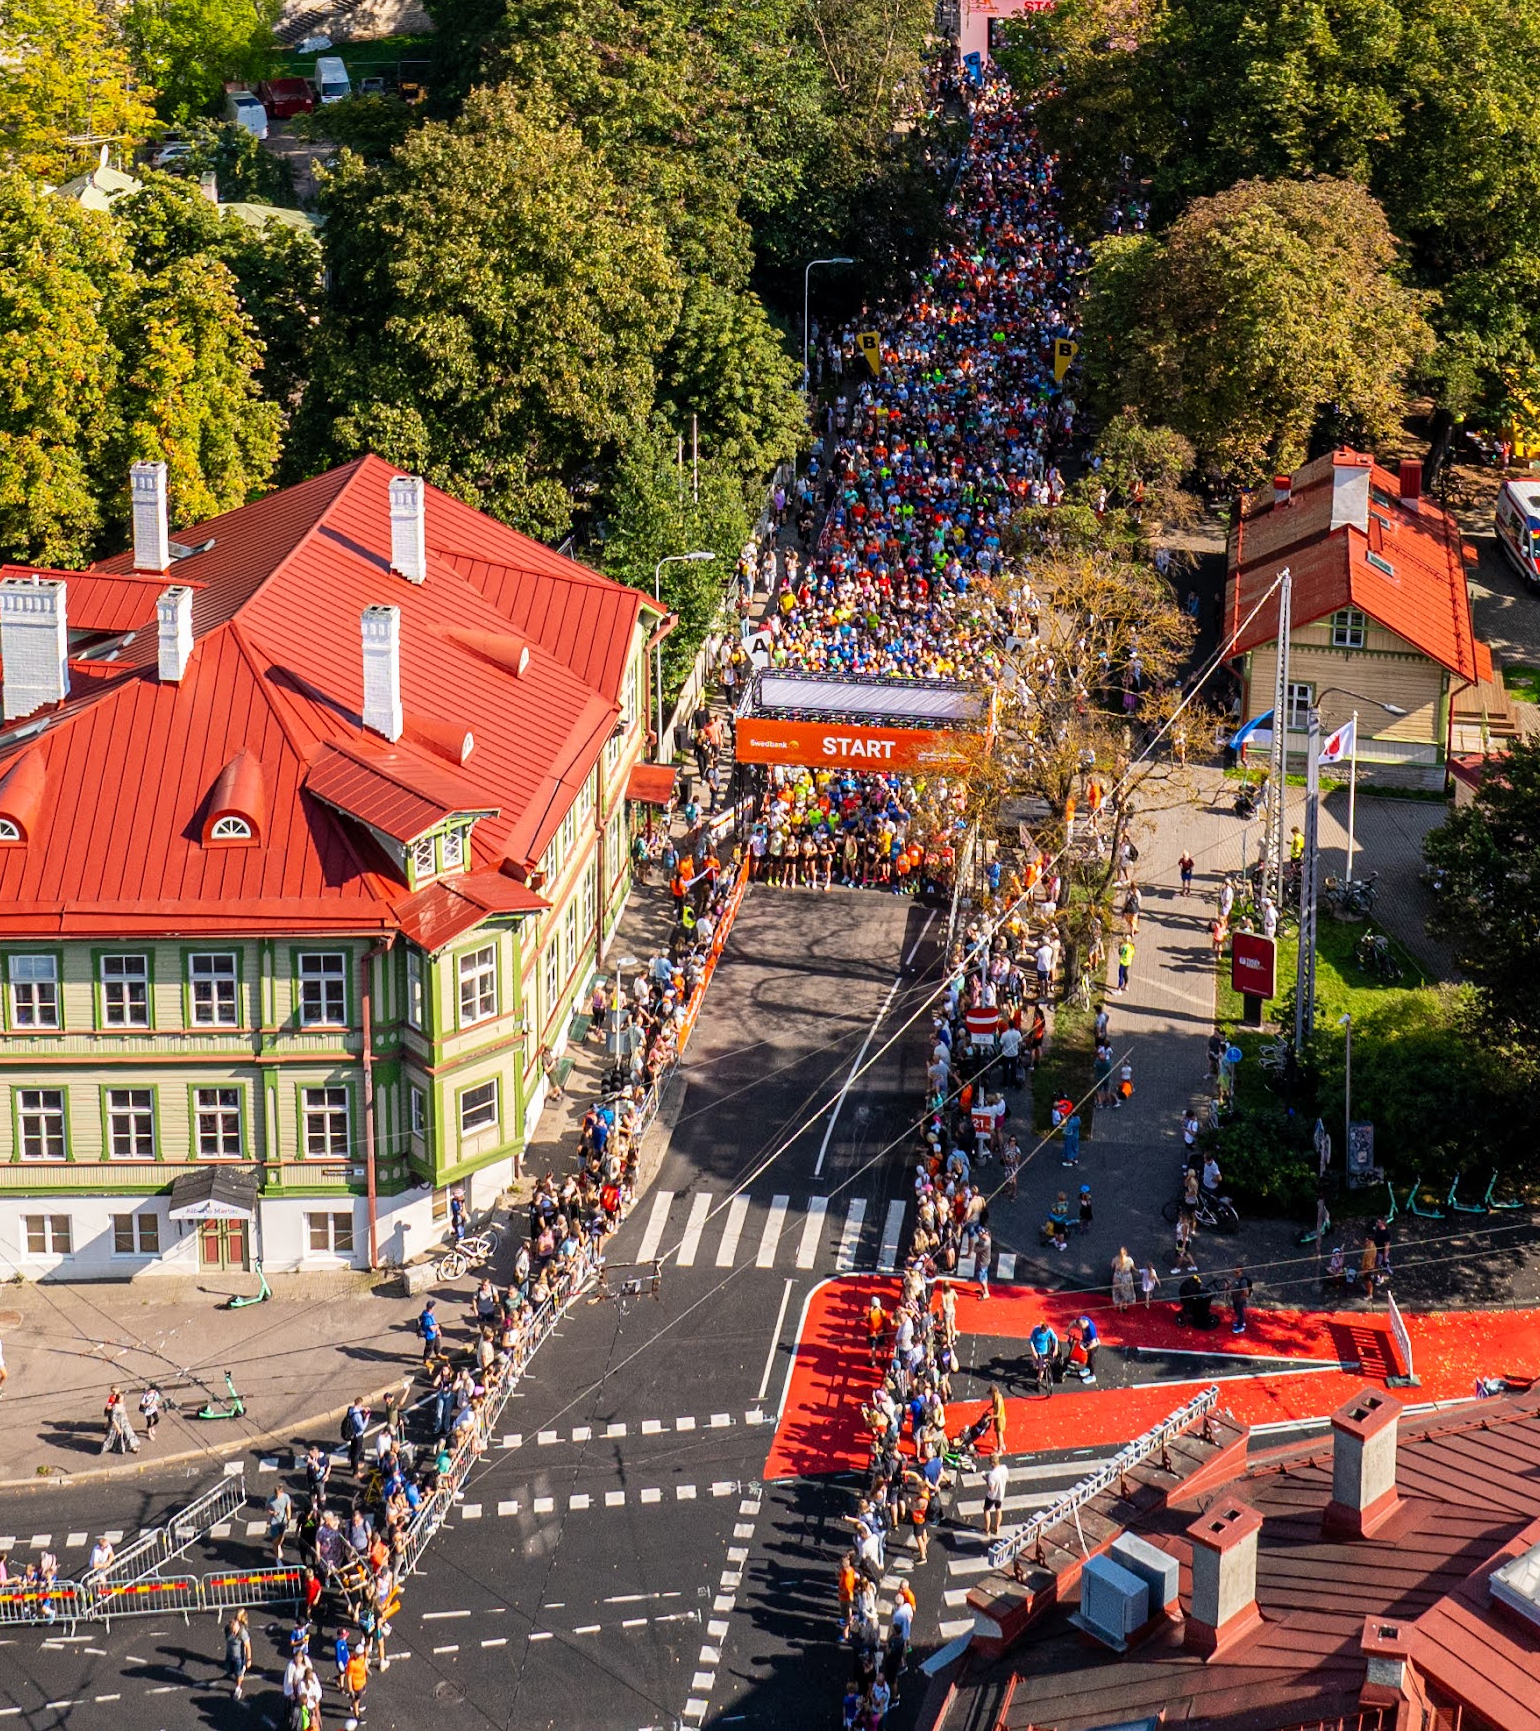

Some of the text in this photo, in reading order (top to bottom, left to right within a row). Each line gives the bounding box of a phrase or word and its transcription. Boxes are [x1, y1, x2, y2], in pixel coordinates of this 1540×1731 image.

[968, 56, 978, 65] C
[863, 336, 876, 348] B
[1059, 343, 1072, 356] B
[752, 638, 769, 654] A
[750, 739, 788, 749] Swedbank
[822, 736, 896, 759] START
[972, 1118, 984, 1128] 21
